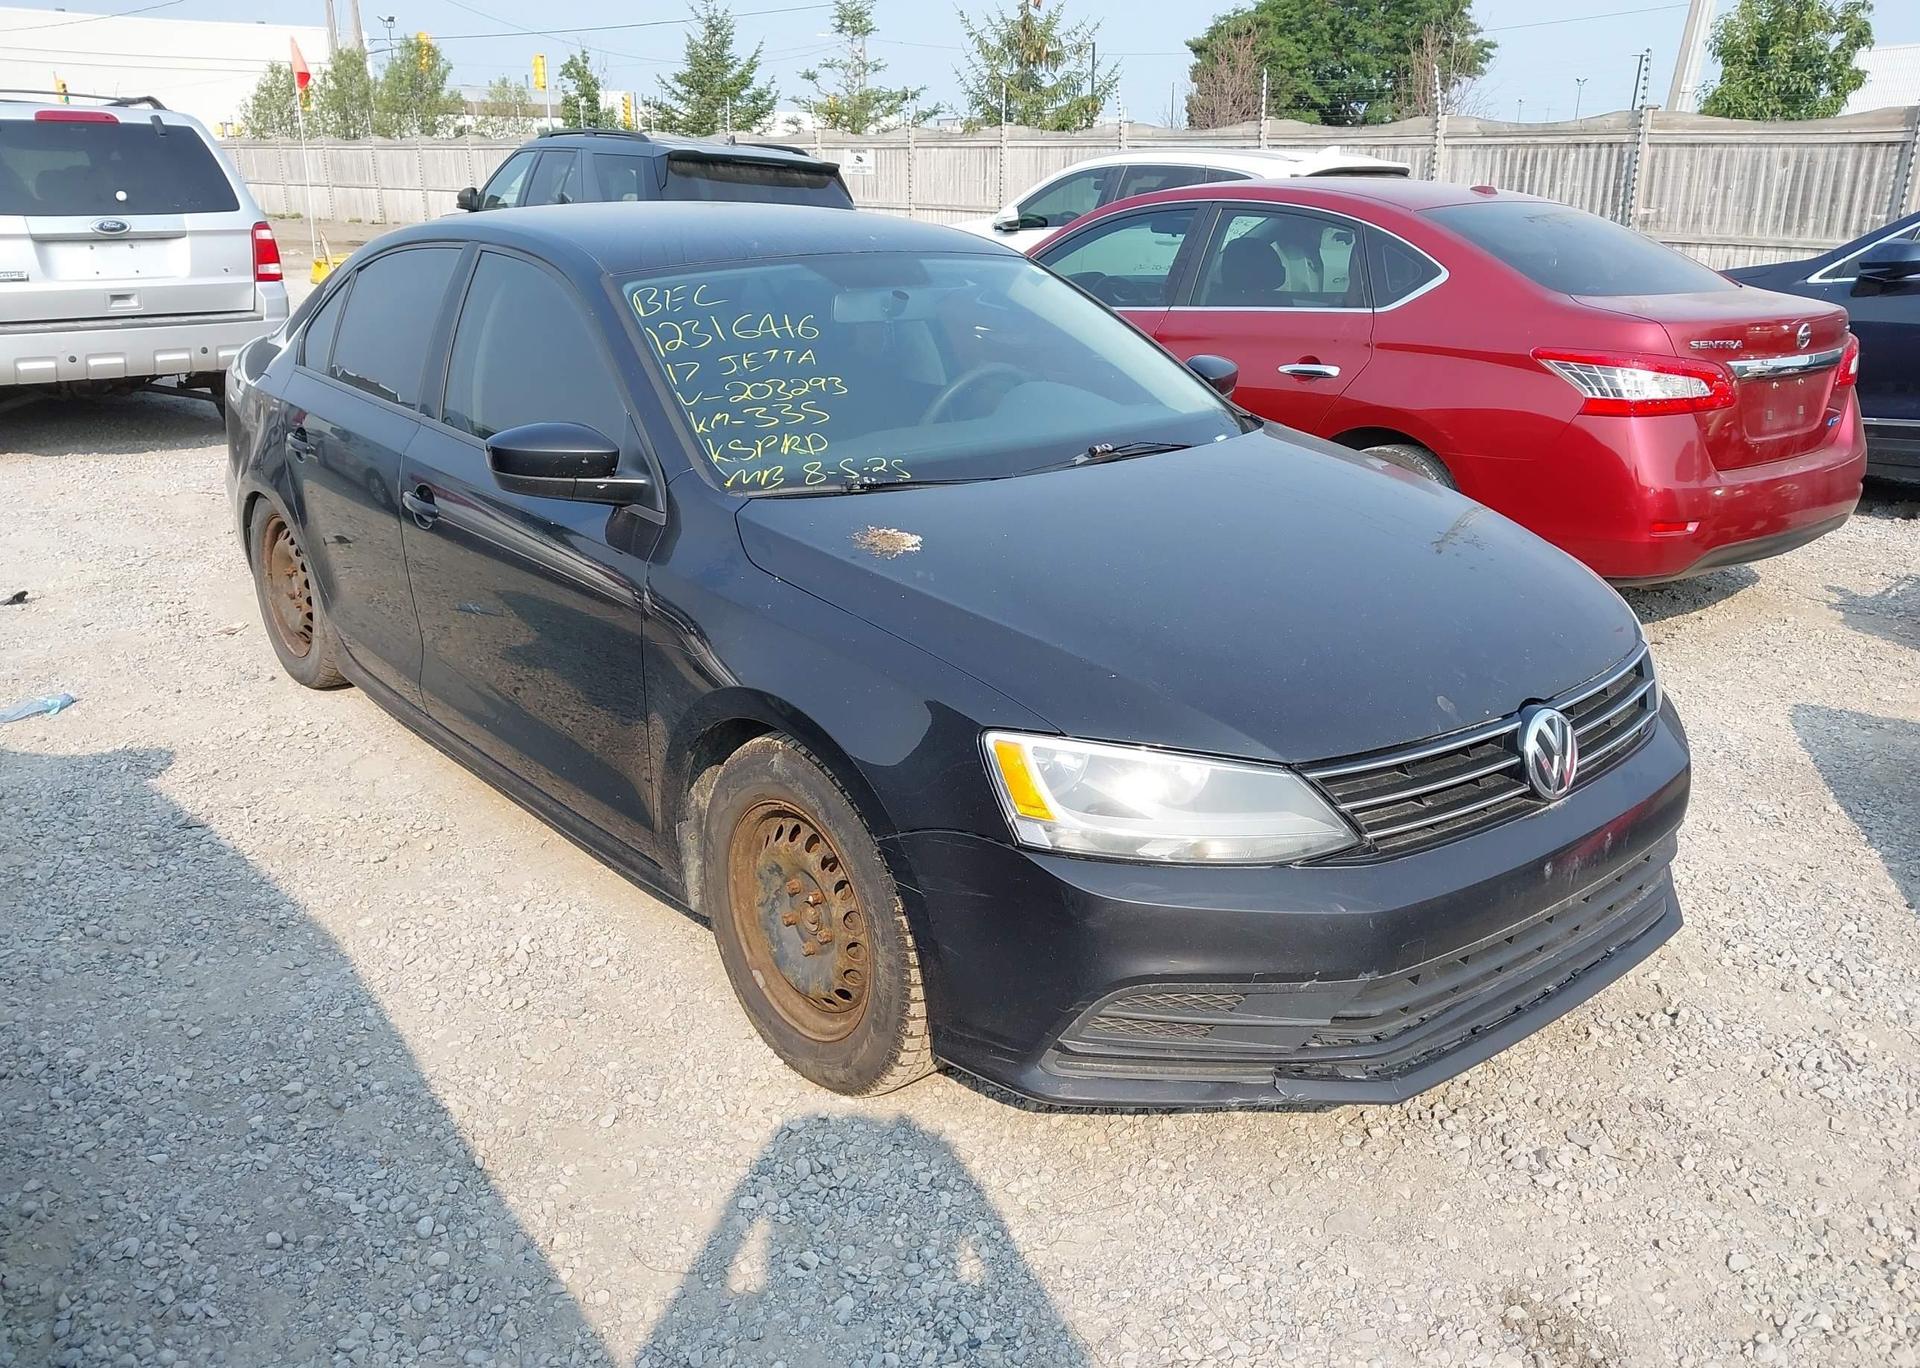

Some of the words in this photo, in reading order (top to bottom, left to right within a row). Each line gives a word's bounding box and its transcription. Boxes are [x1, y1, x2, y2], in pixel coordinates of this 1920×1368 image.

[633, 284, 728, 316] BEC
[645, 313, 820, 357] 12316416
[1689, 339, 1744, 350] SENTRA
[666, 362, 700, 385] 17
[718, 349, 818, 376] JETTA
